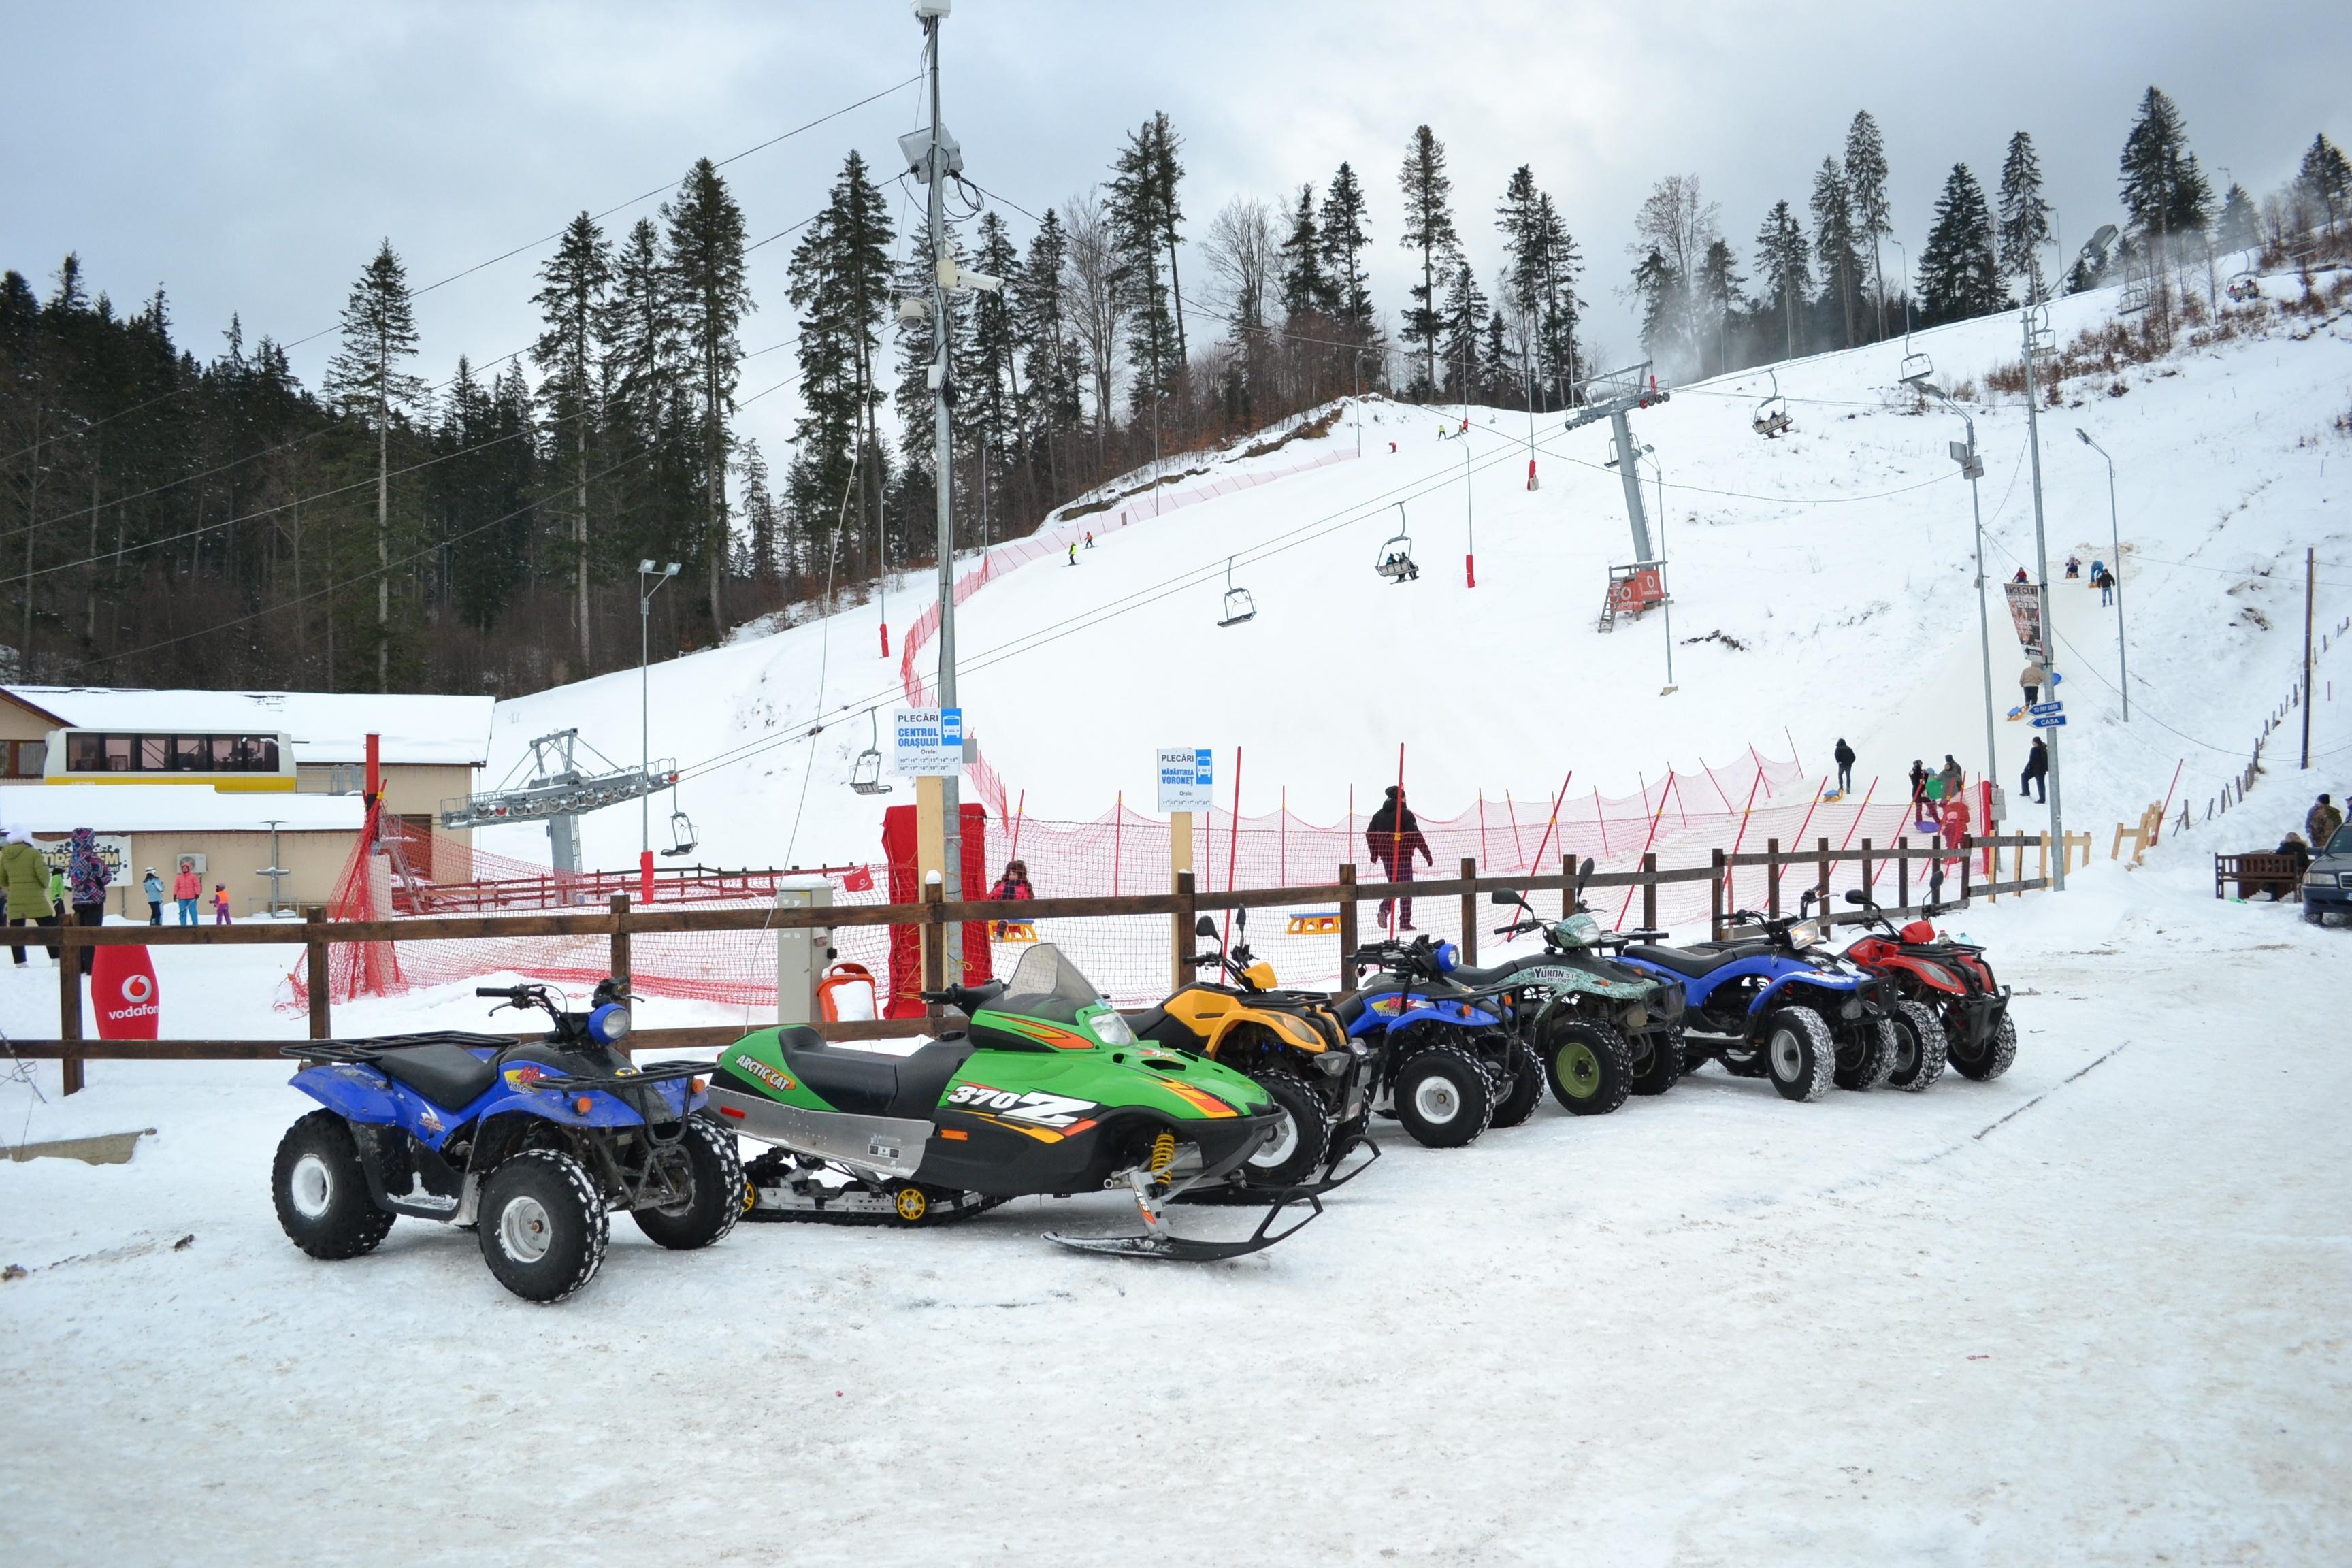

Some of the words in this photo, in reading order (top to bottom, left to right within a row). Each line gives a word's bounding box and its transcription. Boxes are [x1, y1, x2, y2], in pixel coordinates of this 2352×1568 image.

[898, 713, 938, 722] PLECĂRI
[898, 728, 938, 737] CENTRUL
[1534, 968, 1565, 979] YUKON
[108, 1004, 159, 1020] vodafon
[735, 1054, 771, 1081] ARCTIC
[769, 1073, 790, 1091] CAT
[1134, 1191, 1151, 1211] AWS
